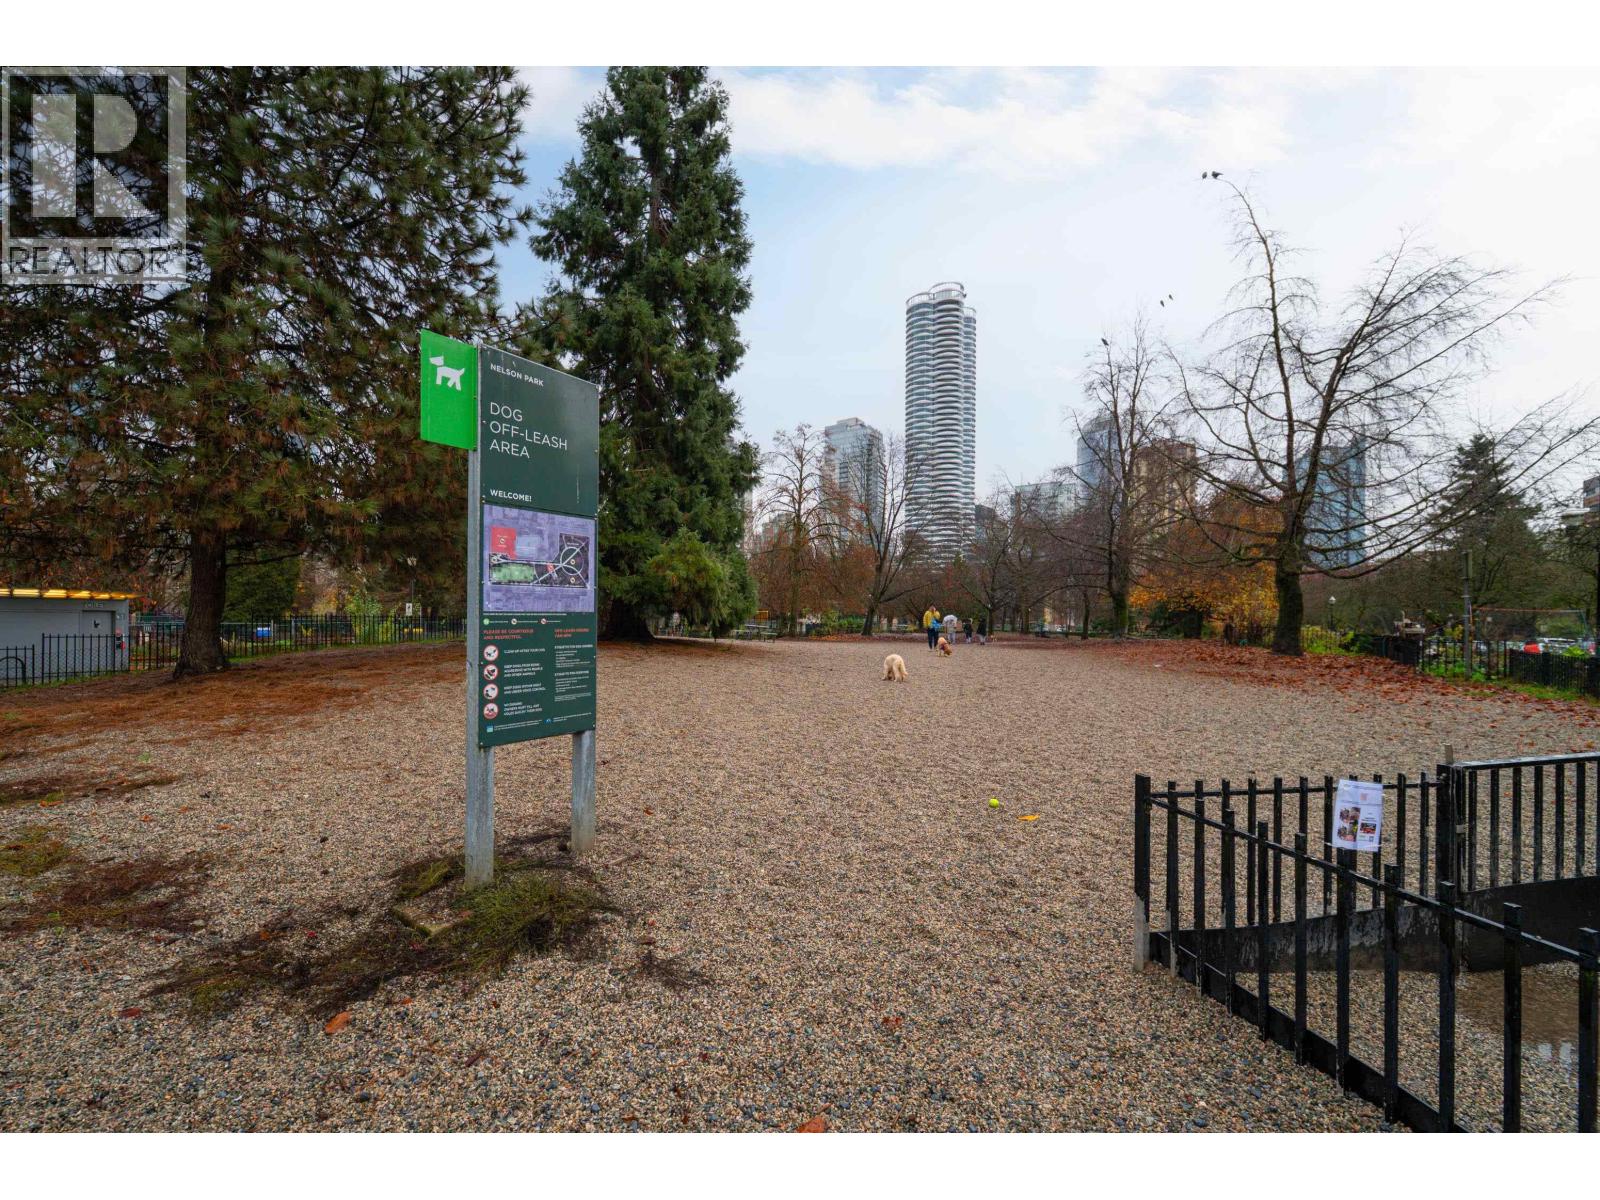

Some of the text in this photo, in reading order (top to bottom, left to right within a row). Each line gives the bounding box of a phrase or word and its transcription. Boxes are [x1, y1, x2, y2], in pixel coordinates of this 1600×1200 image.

[490, 363, 544, 387] NELSON PARK
[490, 401, 523, 422] DOG
[489, 421, 568, 451] OFF-LEASH
[489, 438, 530, 459] AREA
[490, 488, 532, 502] WELCOME!
